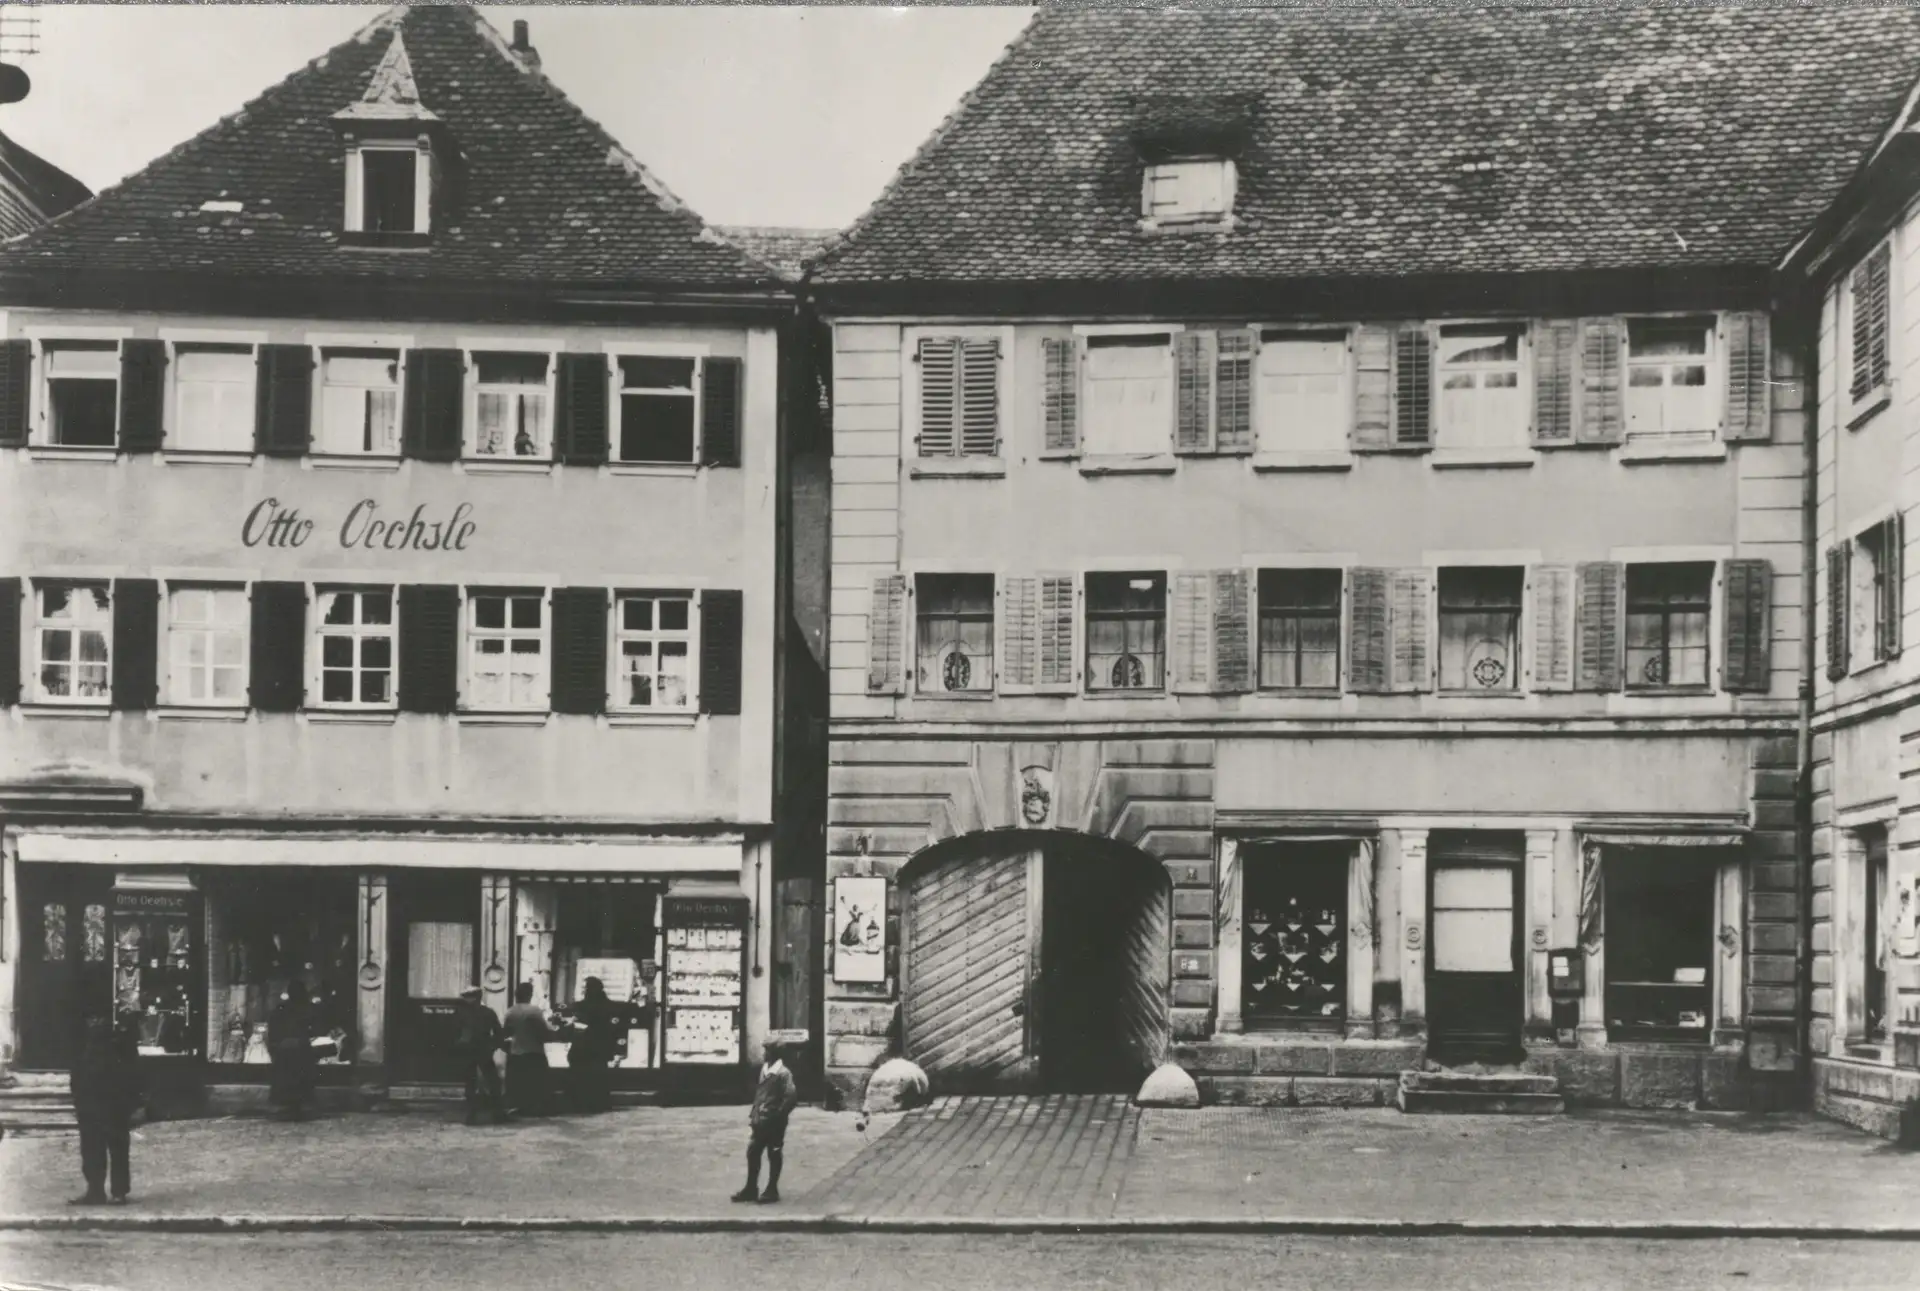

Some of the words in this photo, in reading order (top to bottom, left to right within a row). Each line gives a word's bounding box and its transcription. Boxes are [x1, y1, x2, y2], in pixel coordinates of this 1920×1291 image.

[241, 497, 314, 548] Otto
[339, 498, 477, 551] Oechsle
[116, 894, 138, 905] Otto
